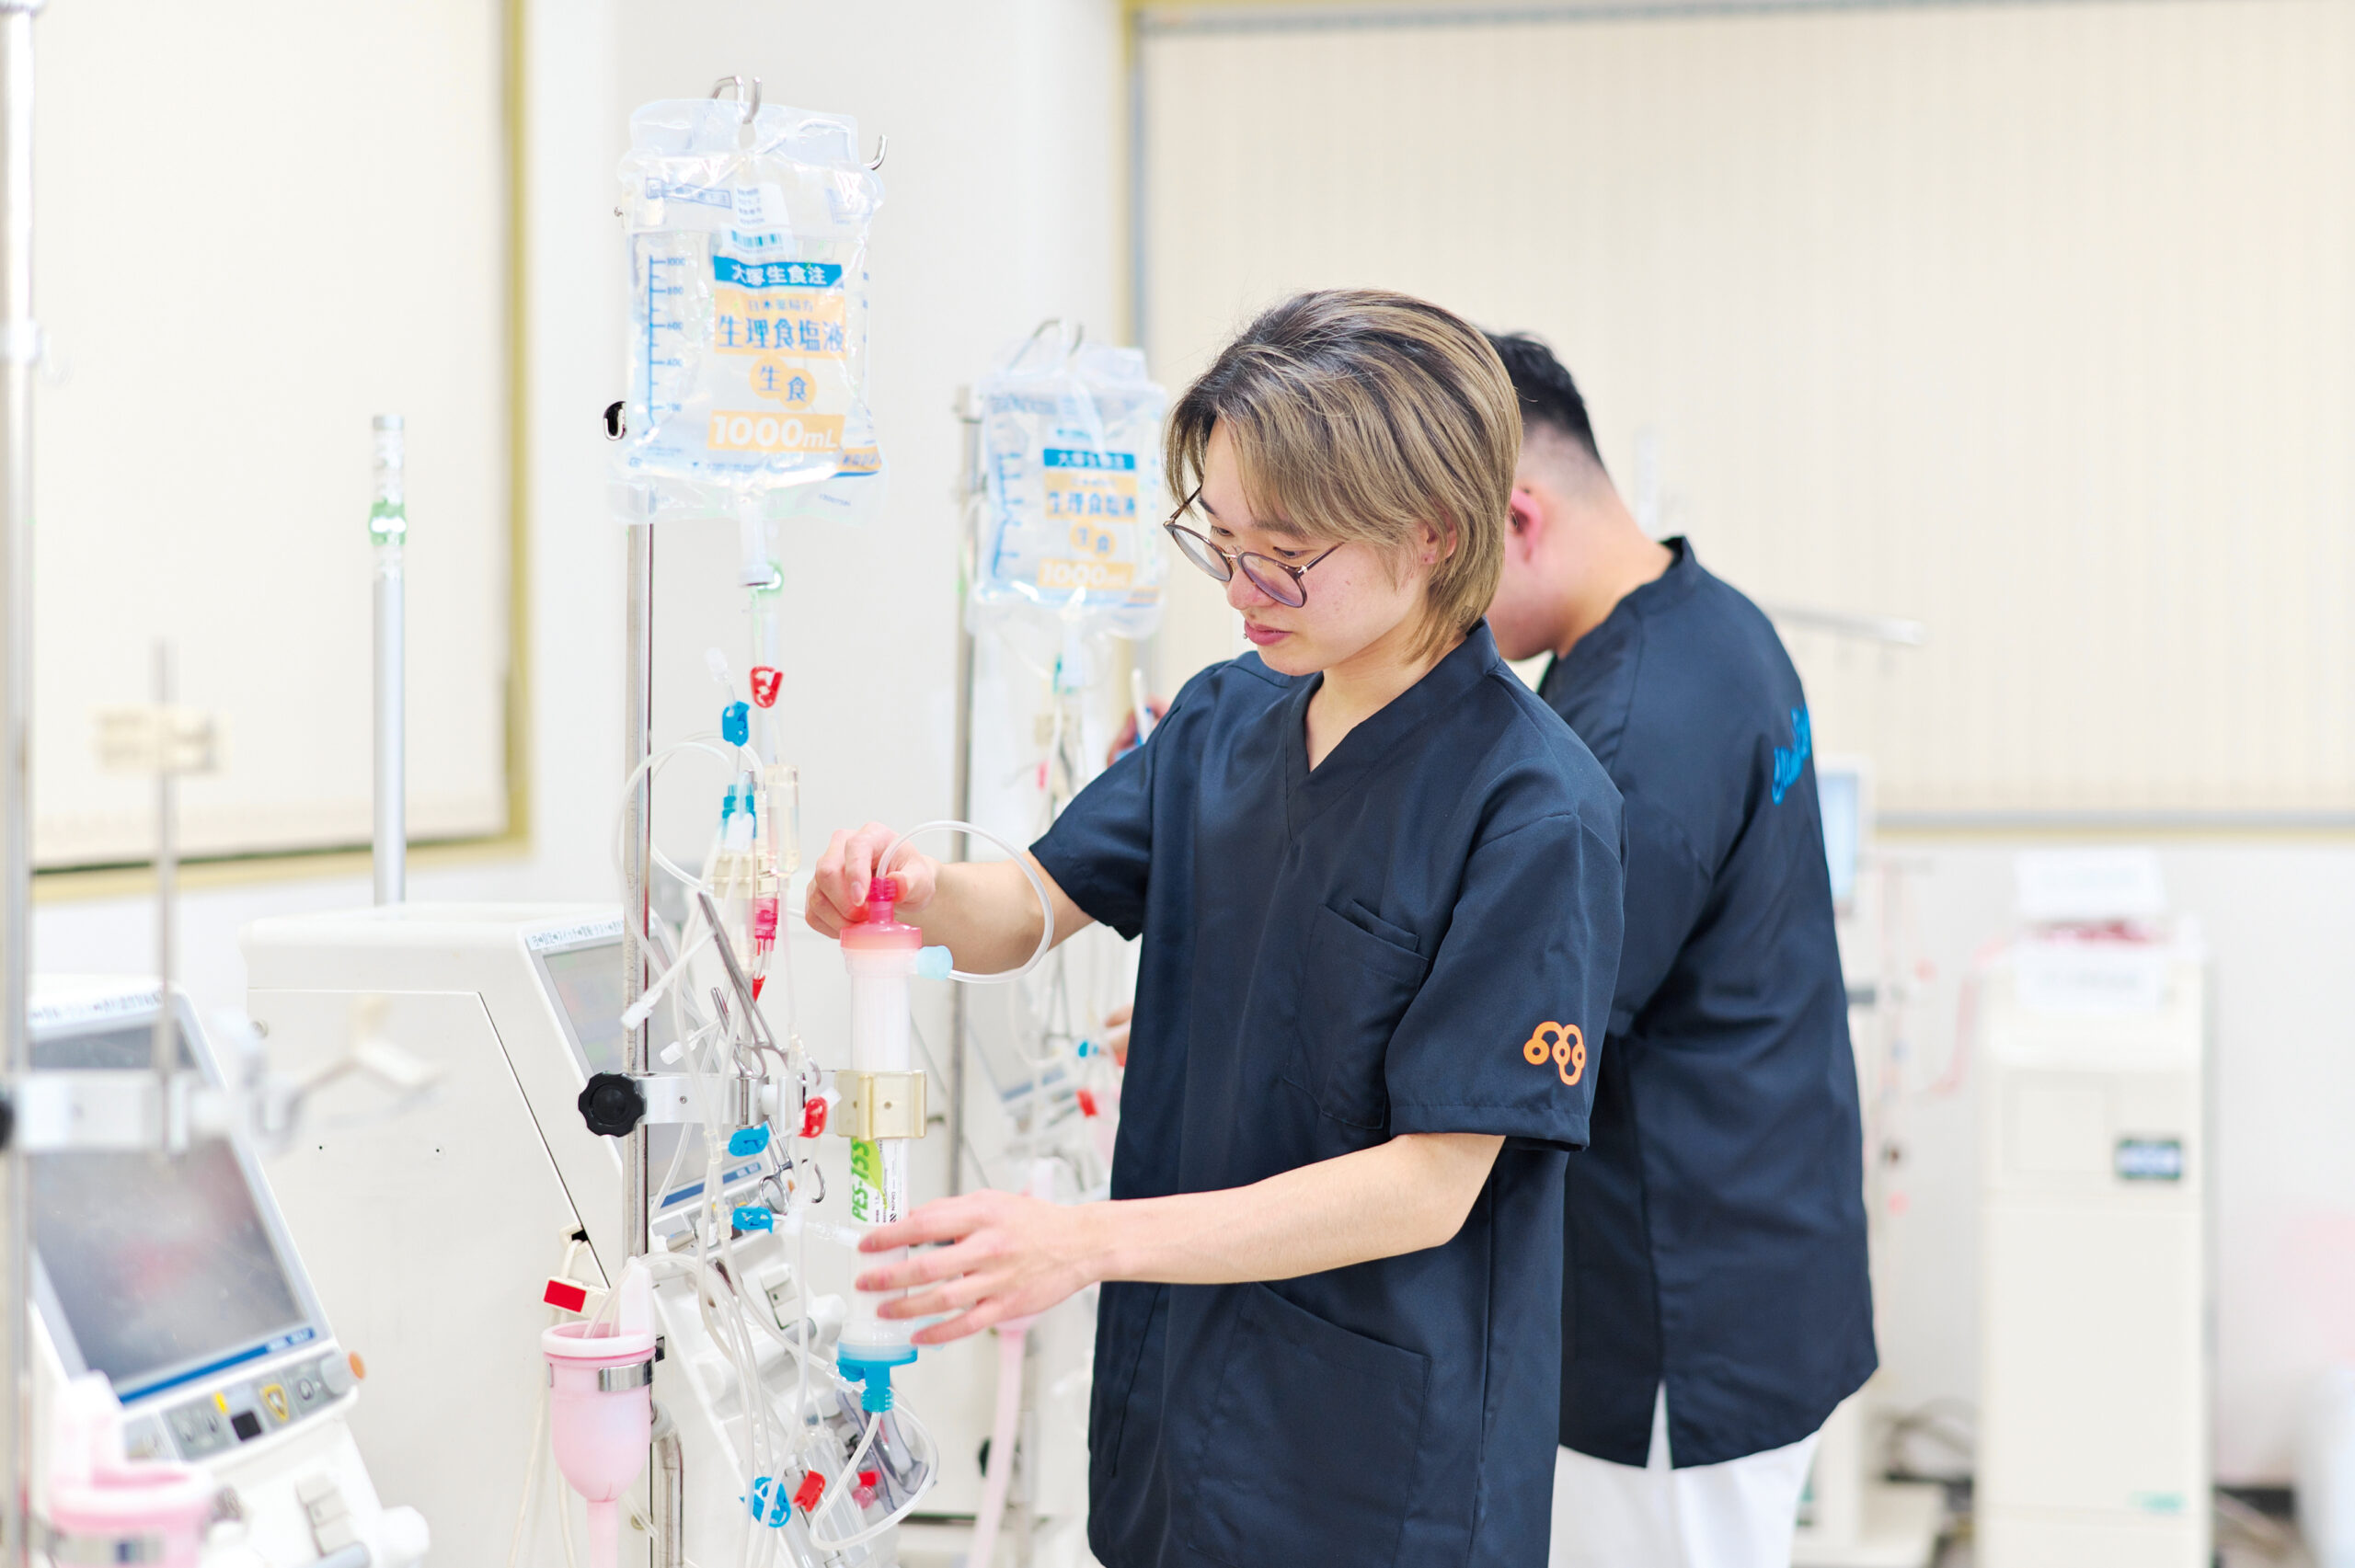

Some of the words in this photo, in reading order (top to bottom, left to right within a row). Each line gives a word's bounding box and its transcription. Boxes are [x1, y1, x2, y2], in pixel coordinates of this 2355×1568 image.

[730, 264, 828, 287] 大塚生食注
[718, 314, 844, 352] 生理食塩液
[758, 364, 809, 404] 生食
[712, 415, 839, 449] 1000mL
